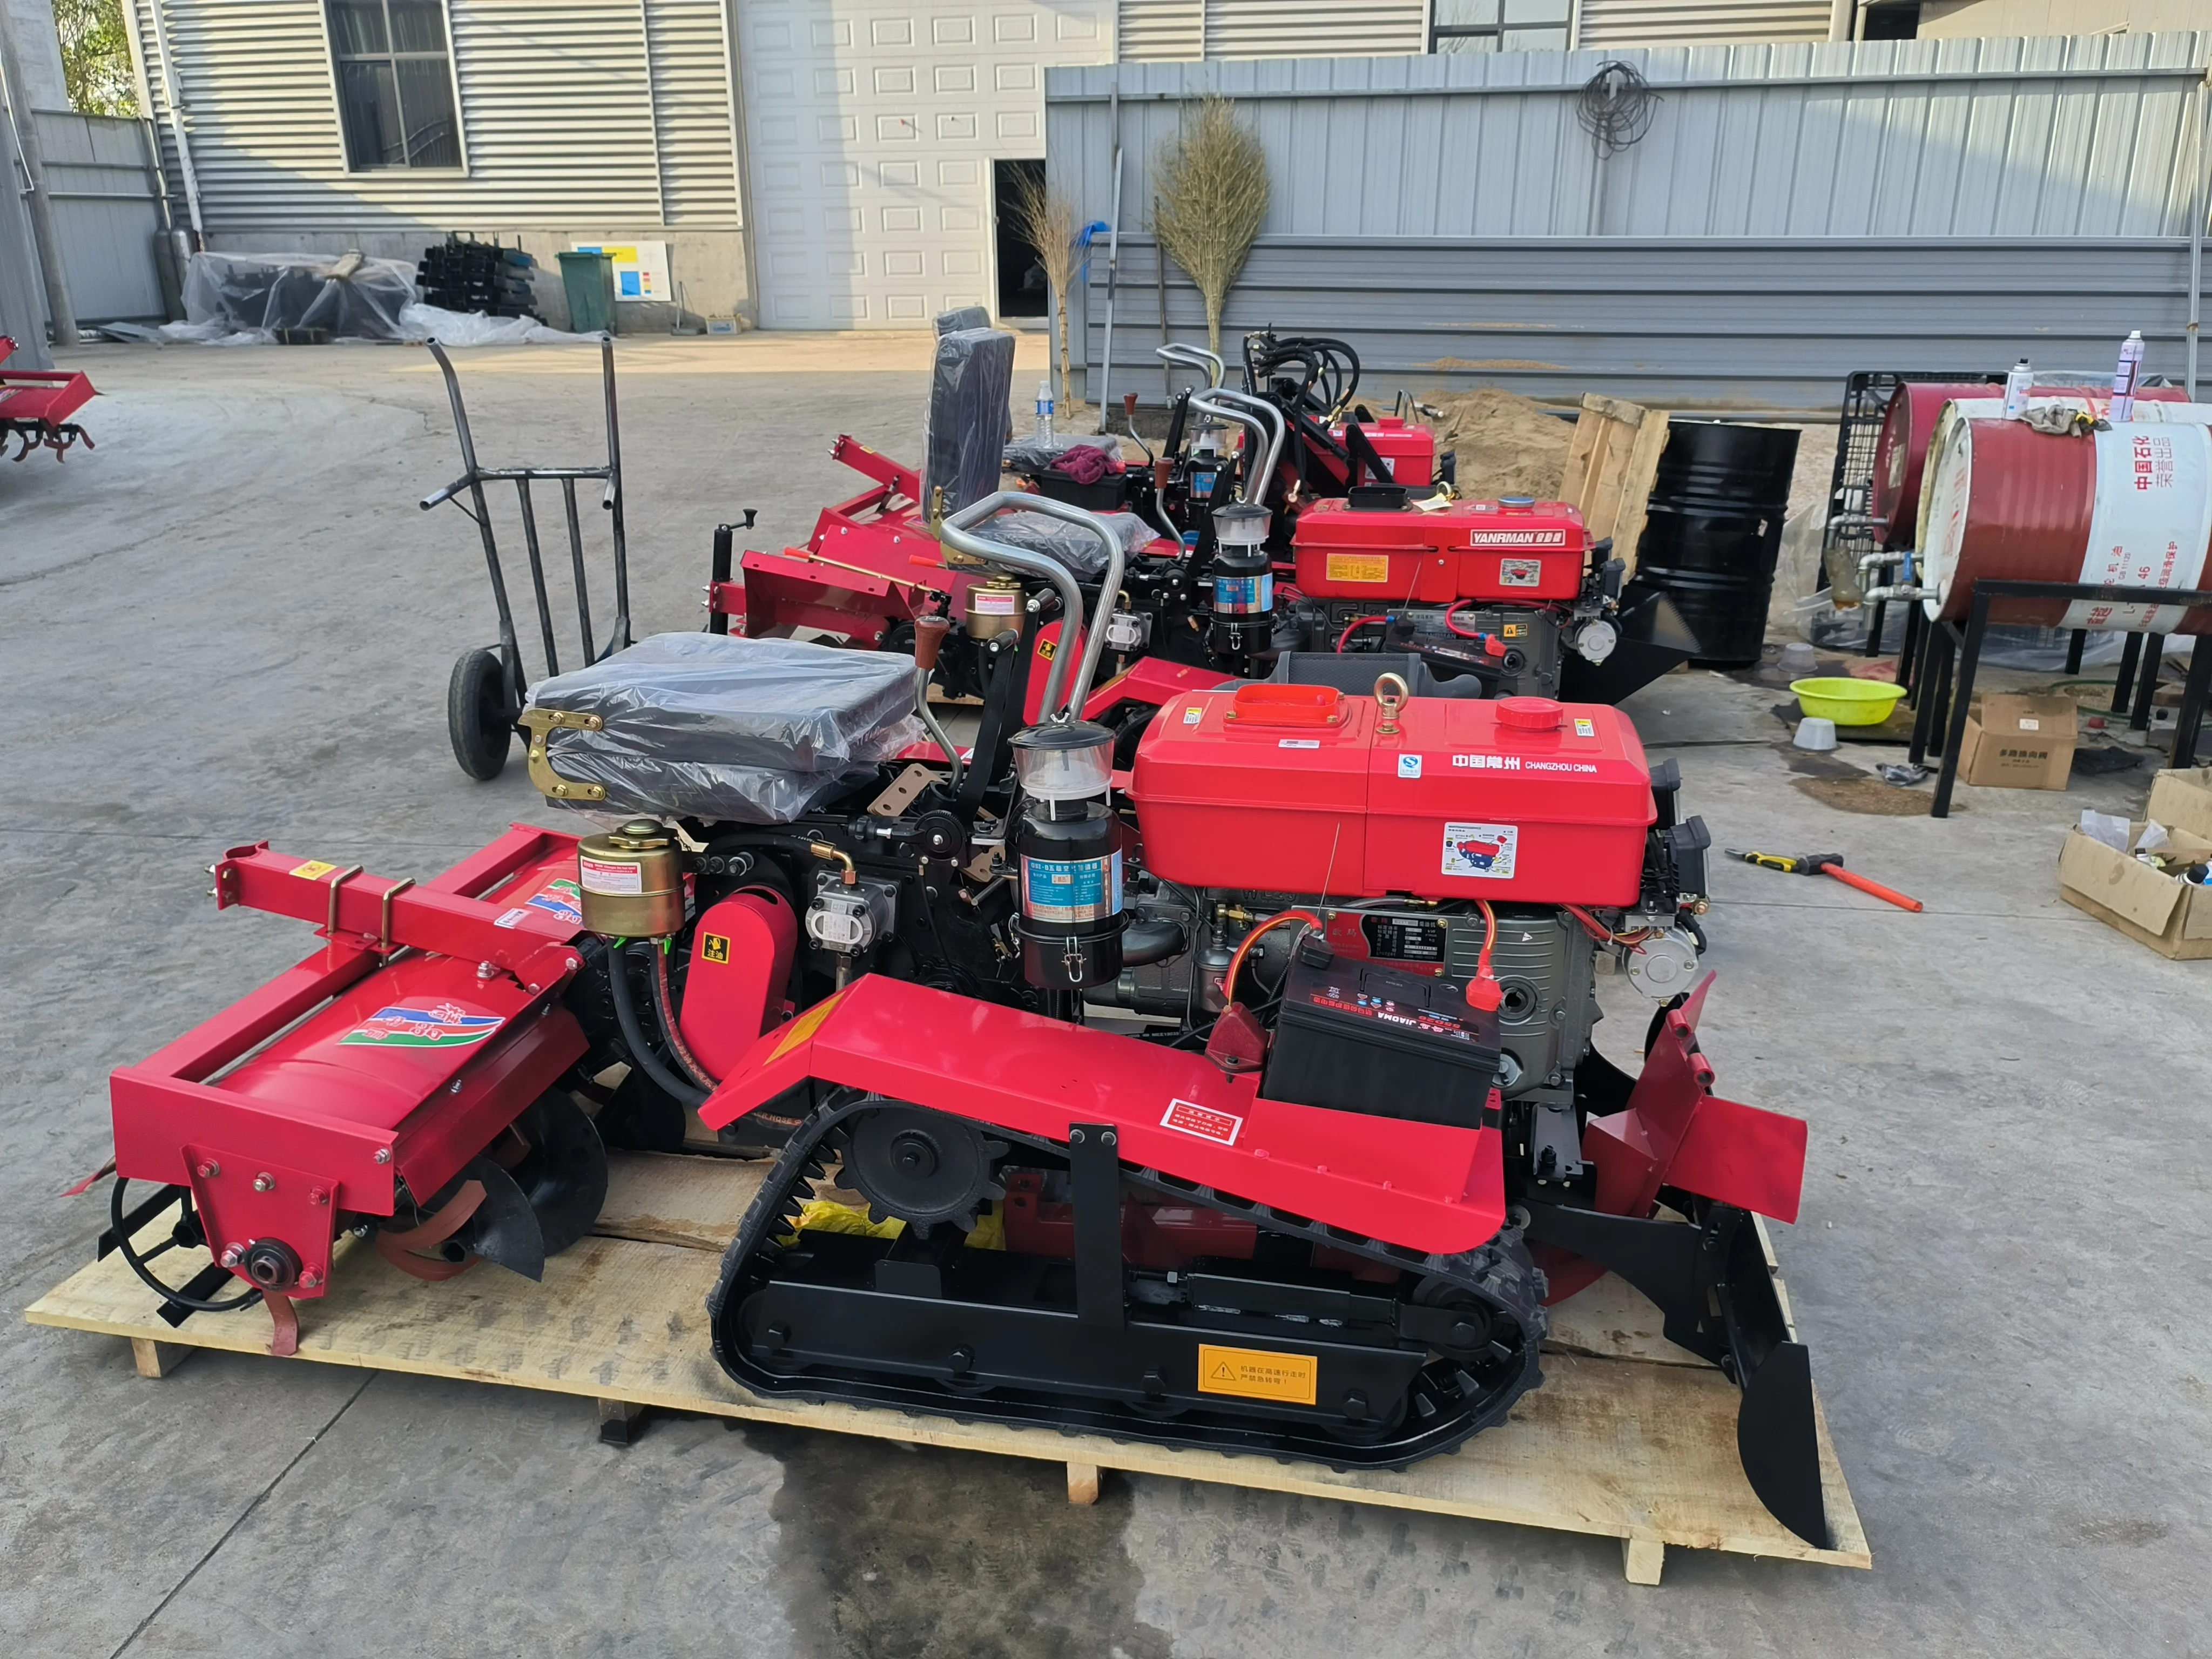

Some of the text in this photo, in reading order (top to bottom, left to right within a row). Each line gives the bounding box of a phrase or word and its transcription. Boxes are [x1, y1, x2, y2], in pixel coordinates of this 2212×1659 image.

[2132, 435, 2153, 490] 中国石化
[2153, 436, 2174, 488] 荣誉出品
[1474, 532, 1534, 543] YANRMAN
[2137, 566, 2150, 579] 46
[1452, 754, 1597, 773] 中国常州 CHANGZHOU CHINA
[707, 949, 723, 960] 注油
[1240, 1365, 1306, 1379] 机器在高速行走时
